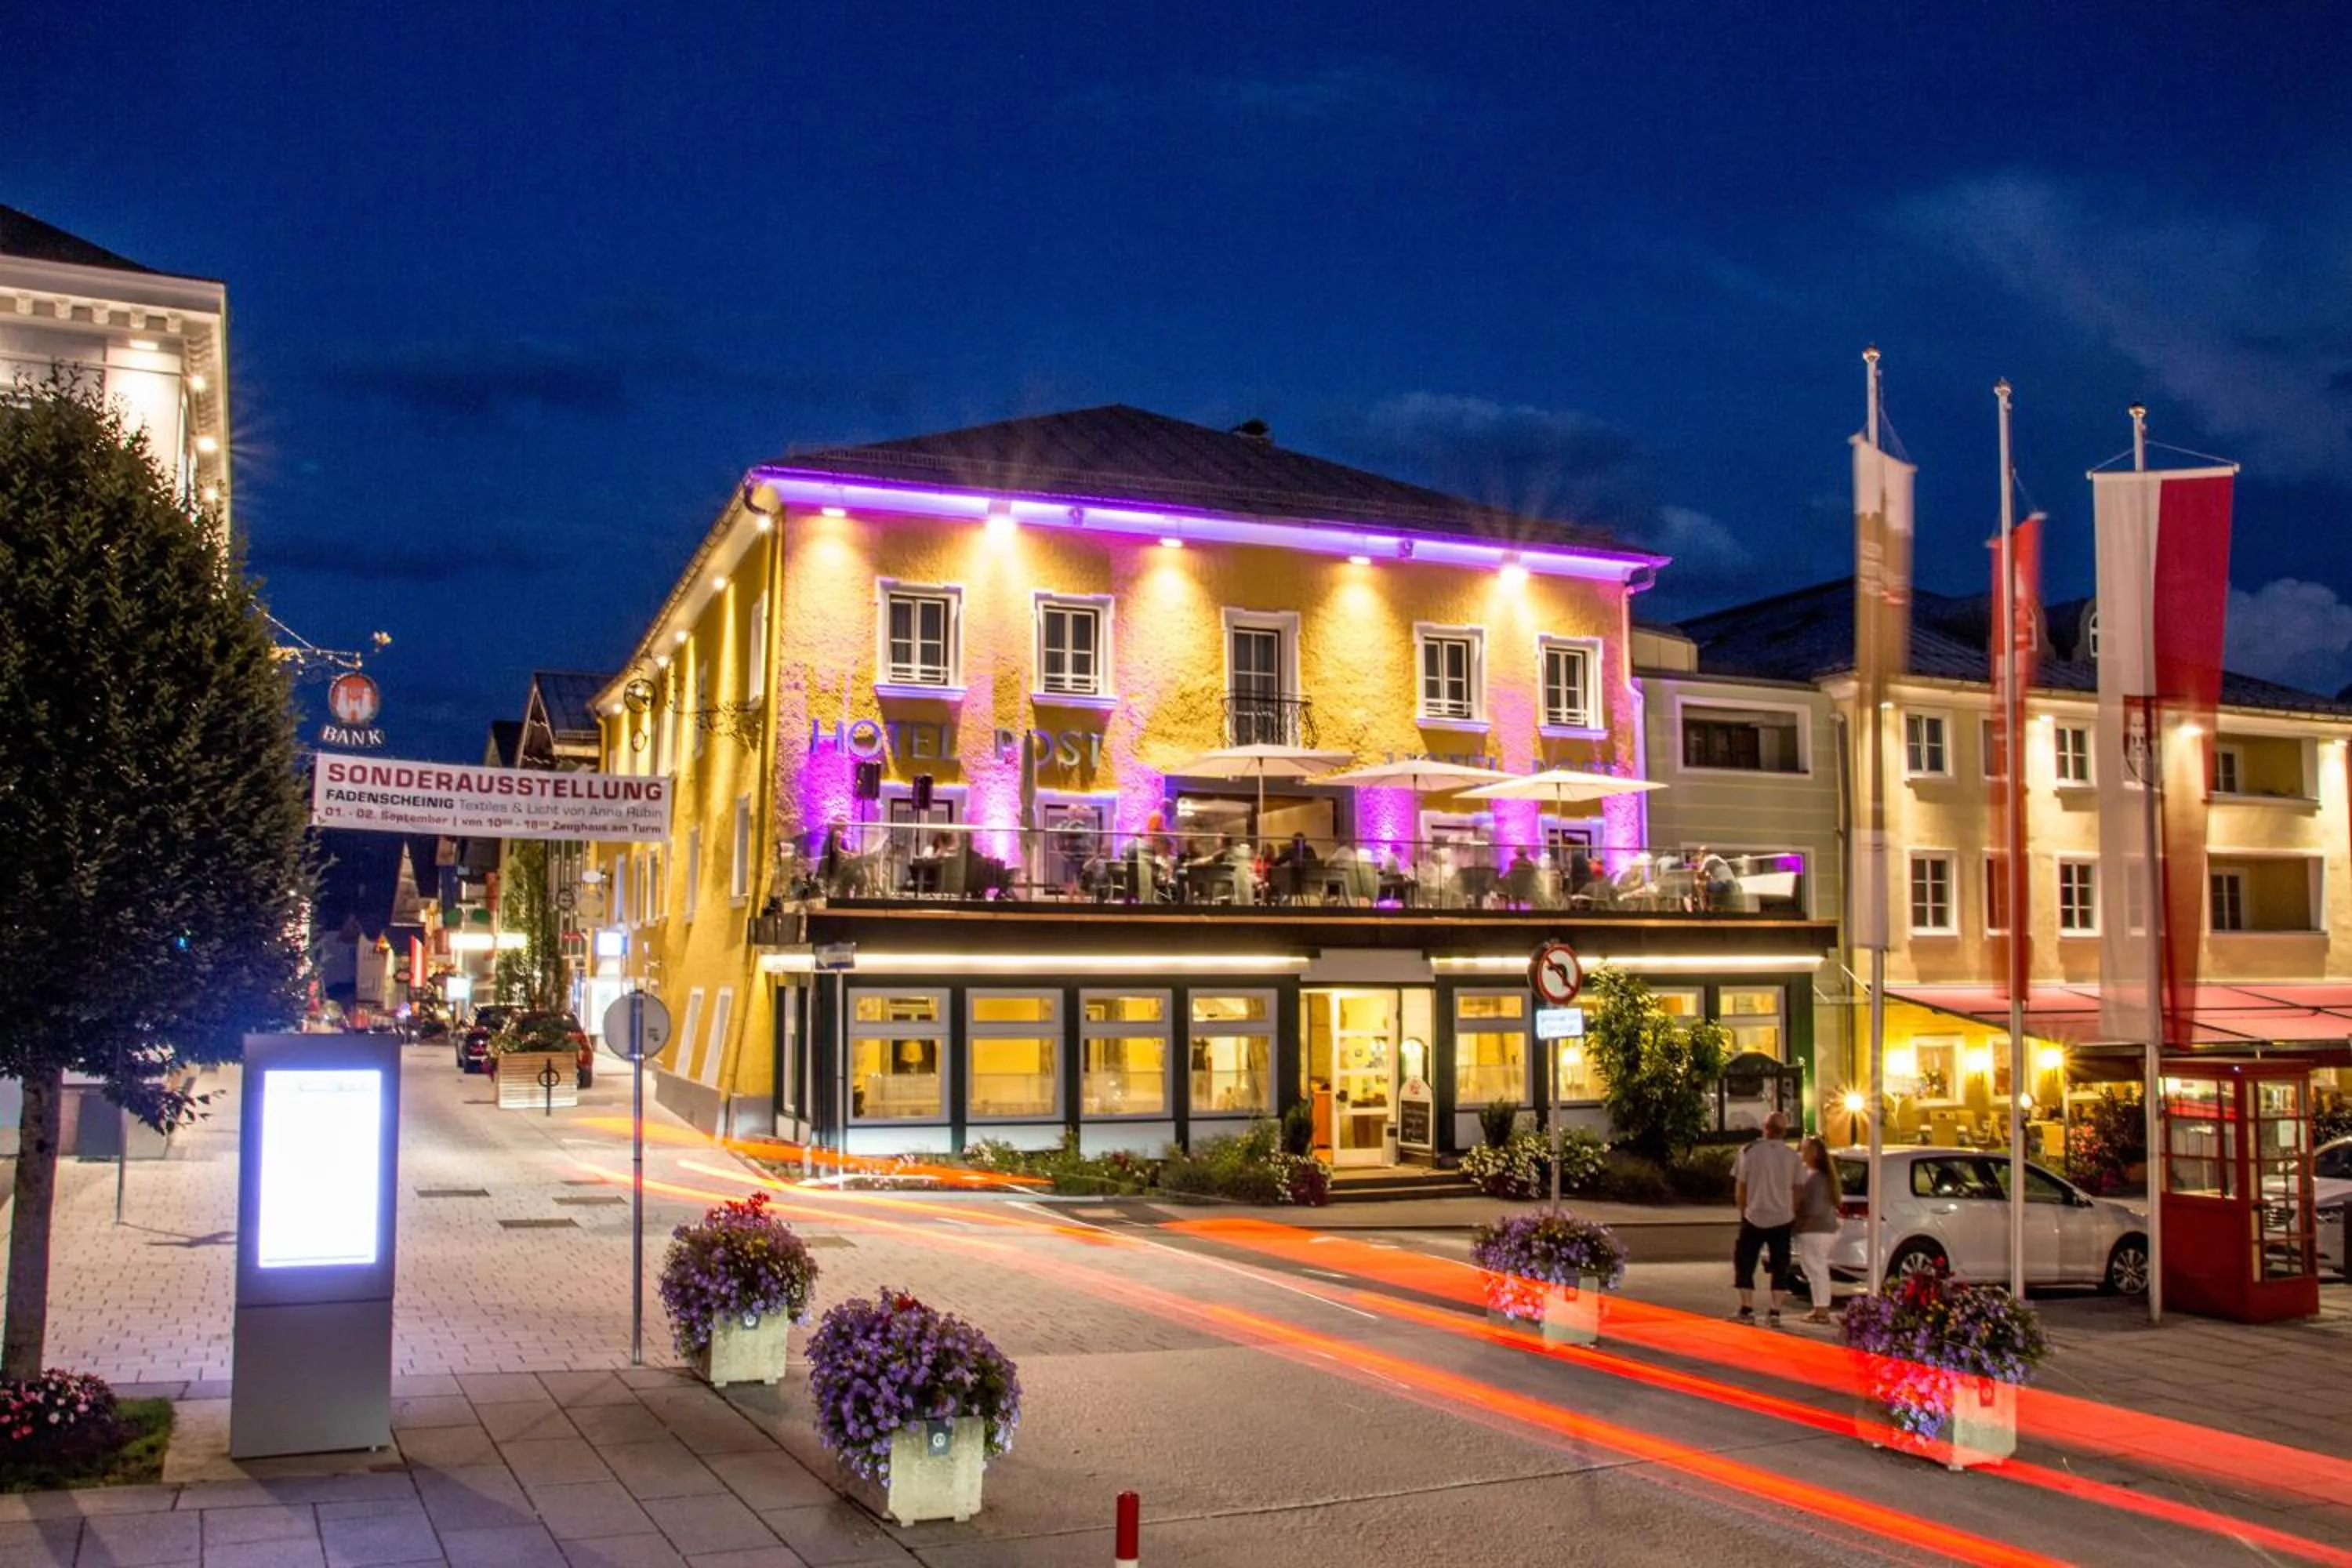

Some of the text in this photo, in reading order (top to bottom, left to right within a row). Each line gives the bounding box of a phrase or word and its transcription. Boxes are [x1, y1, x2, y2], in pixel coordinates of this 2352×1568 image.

[322, 724, 383, 746] BANK
[811, 718, 1104, 768] HOTEL POST
[328, 763, 662, 801] SONDERAUSSTELLUNG
[325, 789, 454, 809] FADENSCHEINIG
[512, 802, 523, 813] &
[527, 803, 559, 816] Licht
[562, 806, 586, 816] von
[380, 810, 448, 824] September
[632, 823, 662, 833] Turm
